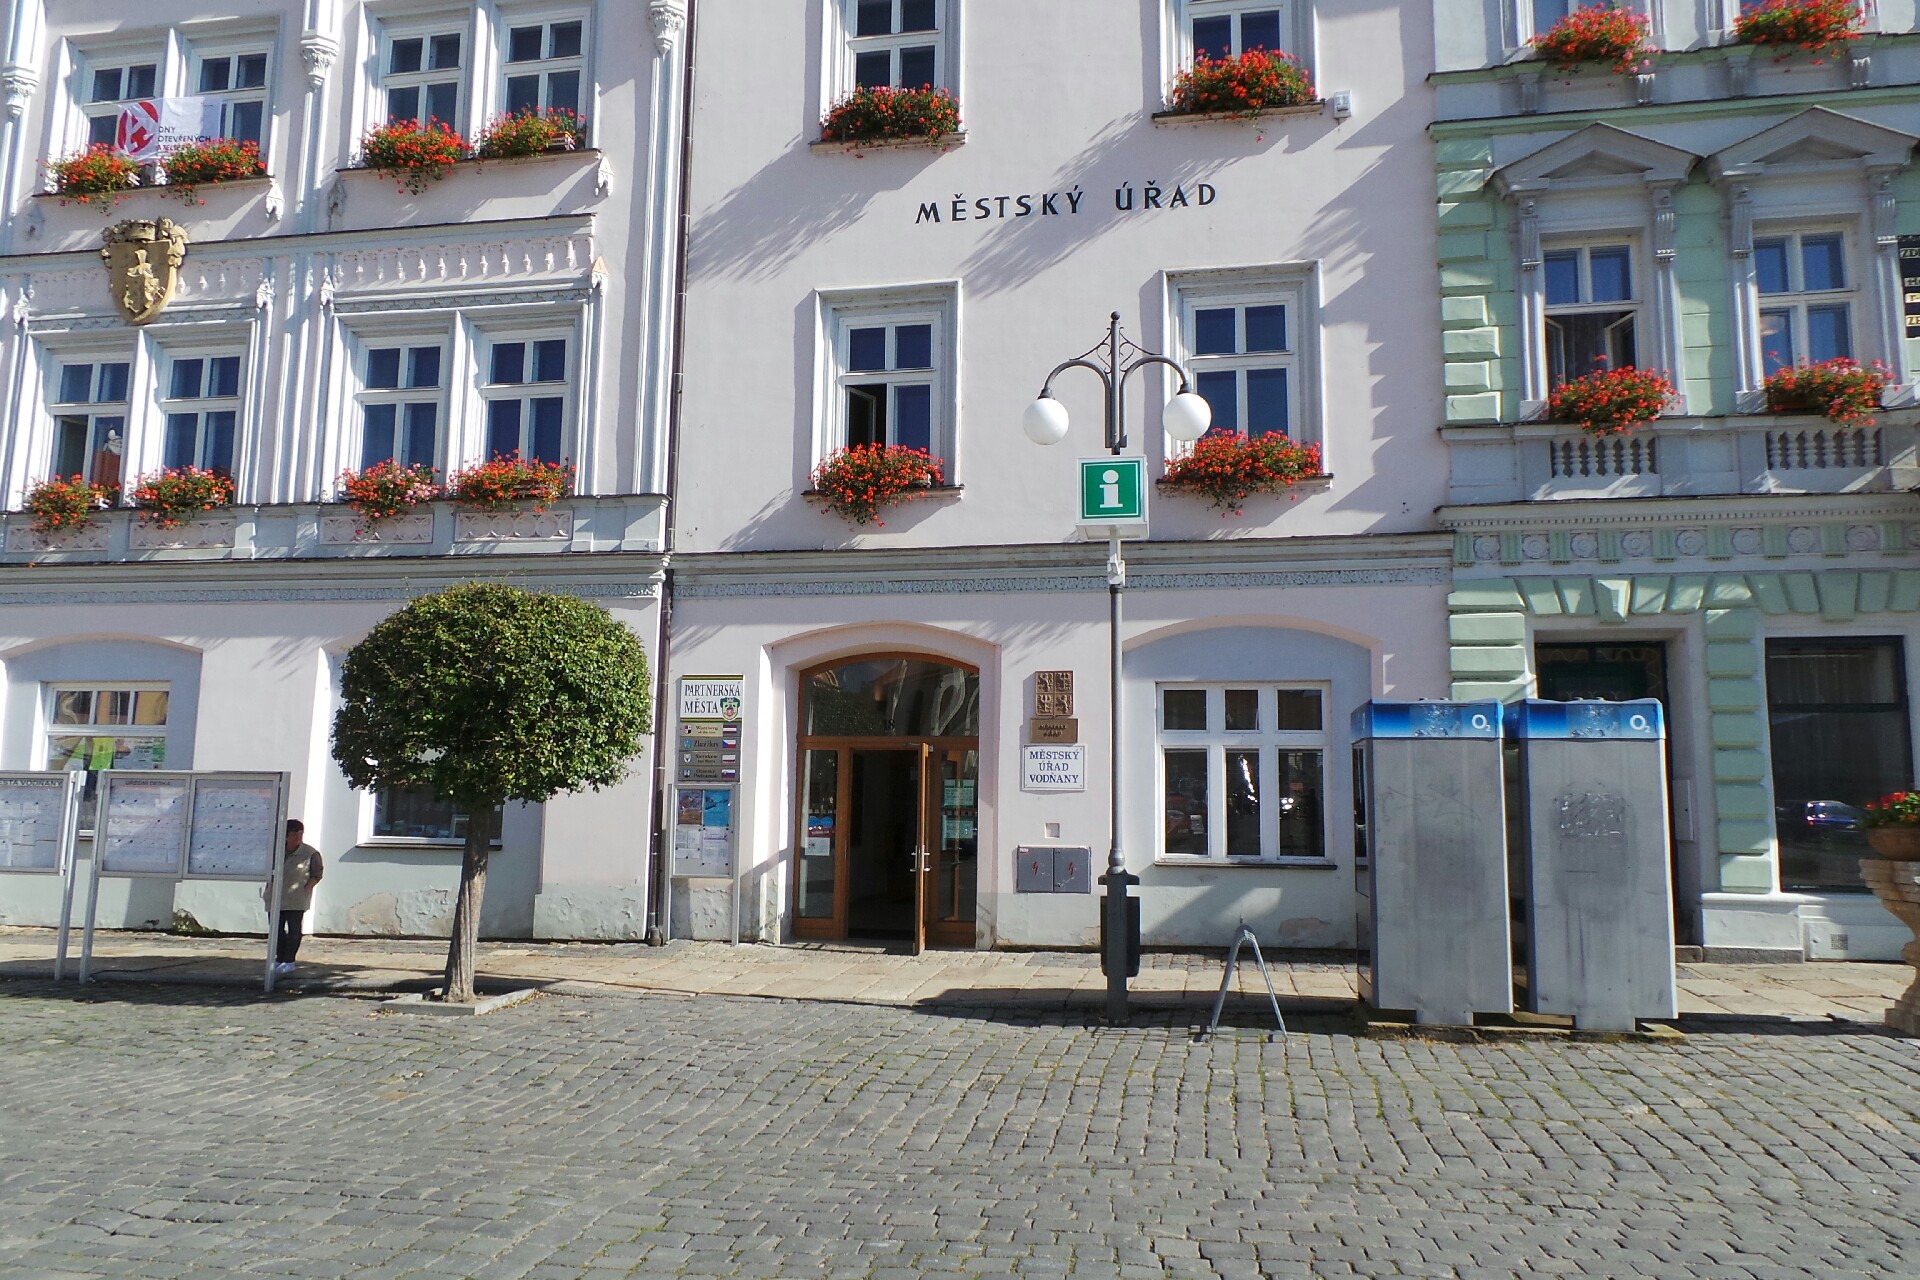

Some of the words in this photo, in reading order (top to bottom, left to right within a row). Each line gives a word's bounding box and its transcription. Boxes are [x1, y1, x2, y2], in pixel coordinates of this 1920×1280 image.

[915, 185, 1084, 224] MĚSTSKÝ
[1115, 180, 1216, 211] ÚŘAD
[685, 681, 741, 696] PARTNERSKÁ
[684, 698, 719, 713] MĚSTA
[1471, 713, 1491, 732] O2
[1629, 714, 1650, 733] O2
[1029, 749, 1080, 760] MĚSTSKÝ
[1038, 760, 1069, 771] ÚŘAD
[1029, 771, 1079, 783] VODŇANY
